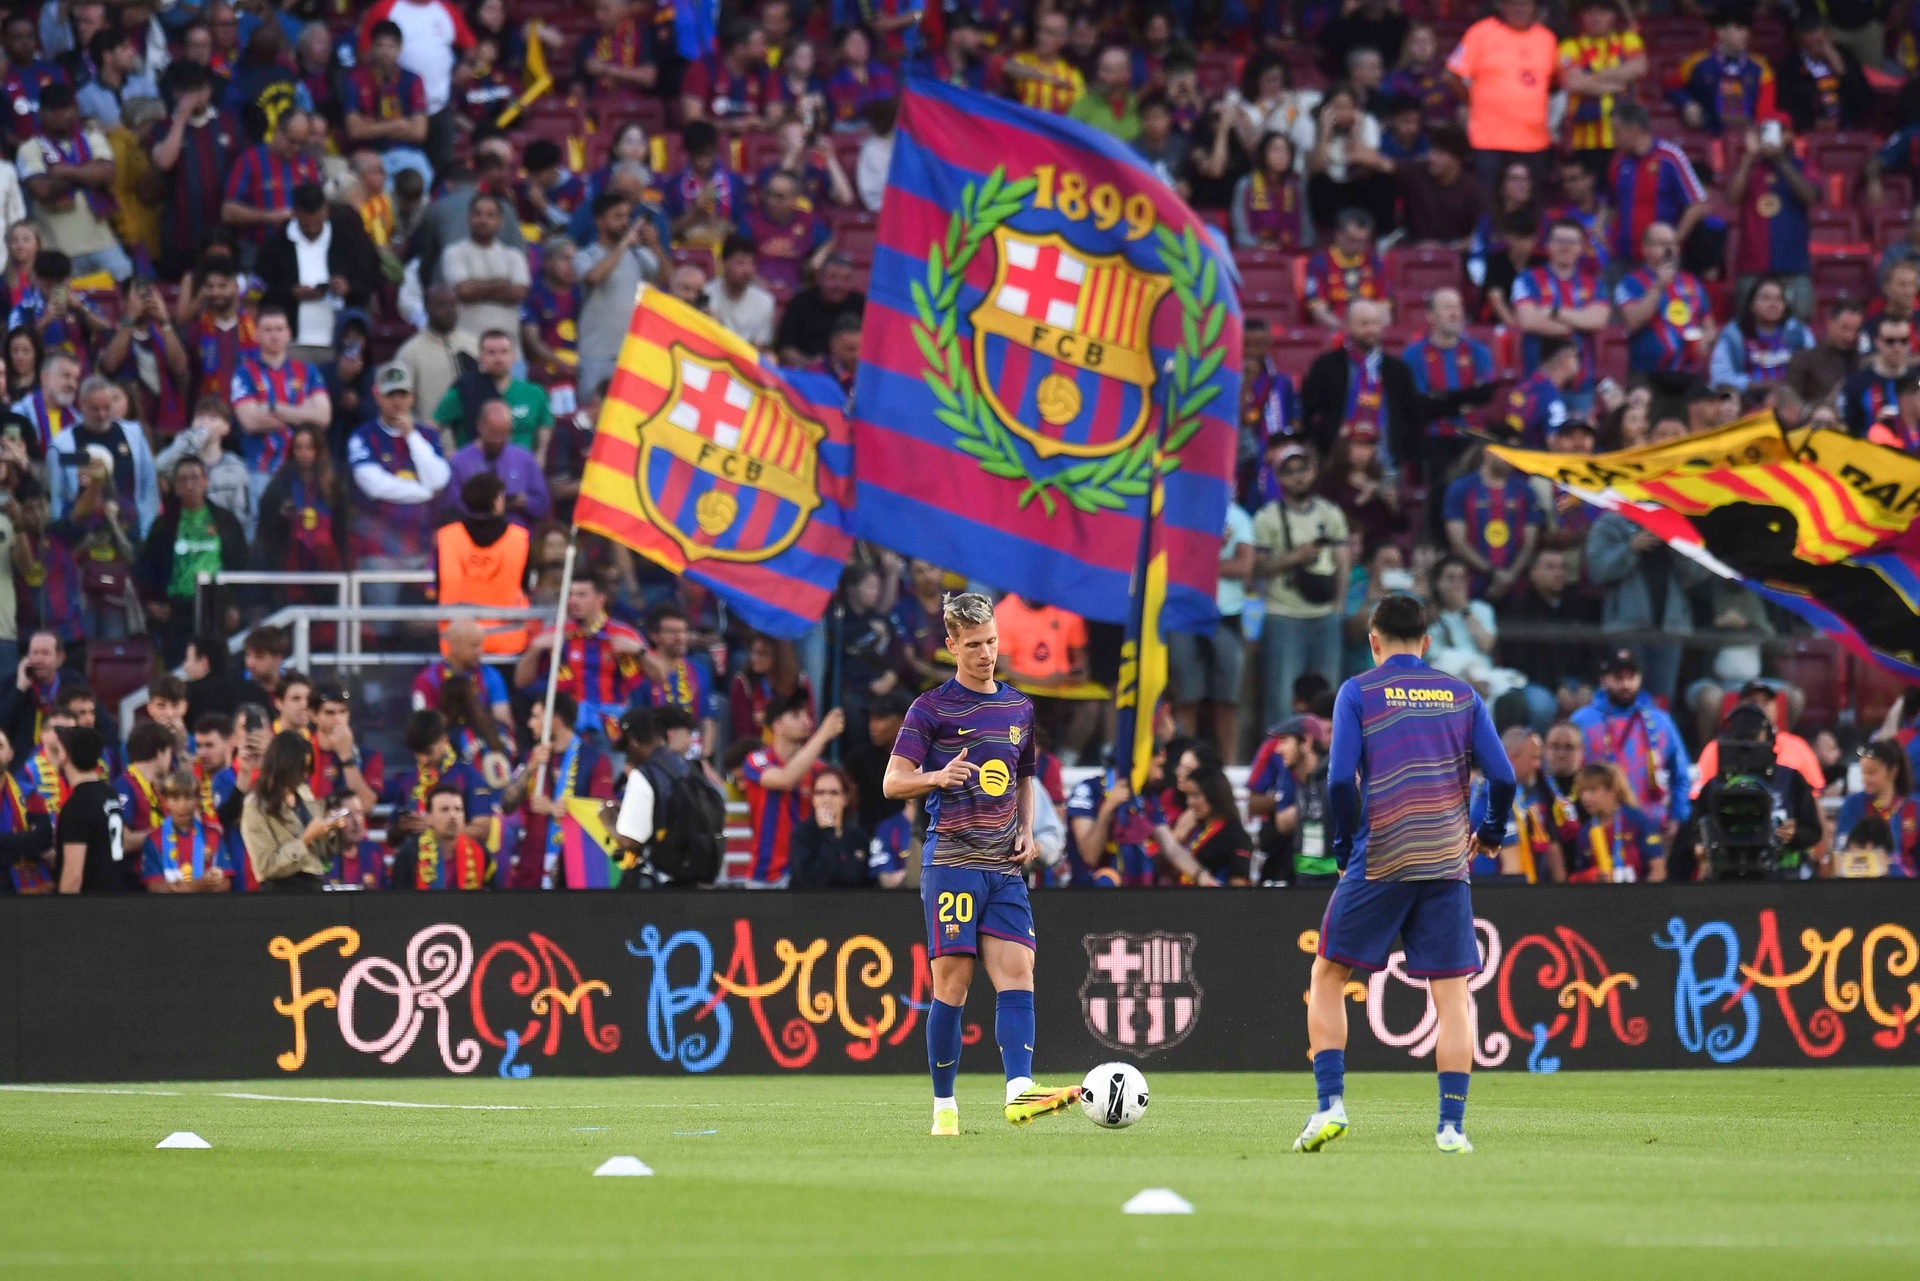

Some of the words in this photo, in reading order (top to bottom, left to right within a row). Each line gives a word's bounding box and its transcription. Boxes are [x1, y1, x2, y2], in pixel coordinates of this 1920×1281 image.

[1033, 165, 1156, 241] 1899
[1031, 325, 1104, 367] FCB
[1385, 687, 1408, 700] R.D.
[1409, 689, 1454, 702] CONGO
[938, 891, 974, 923] 20
